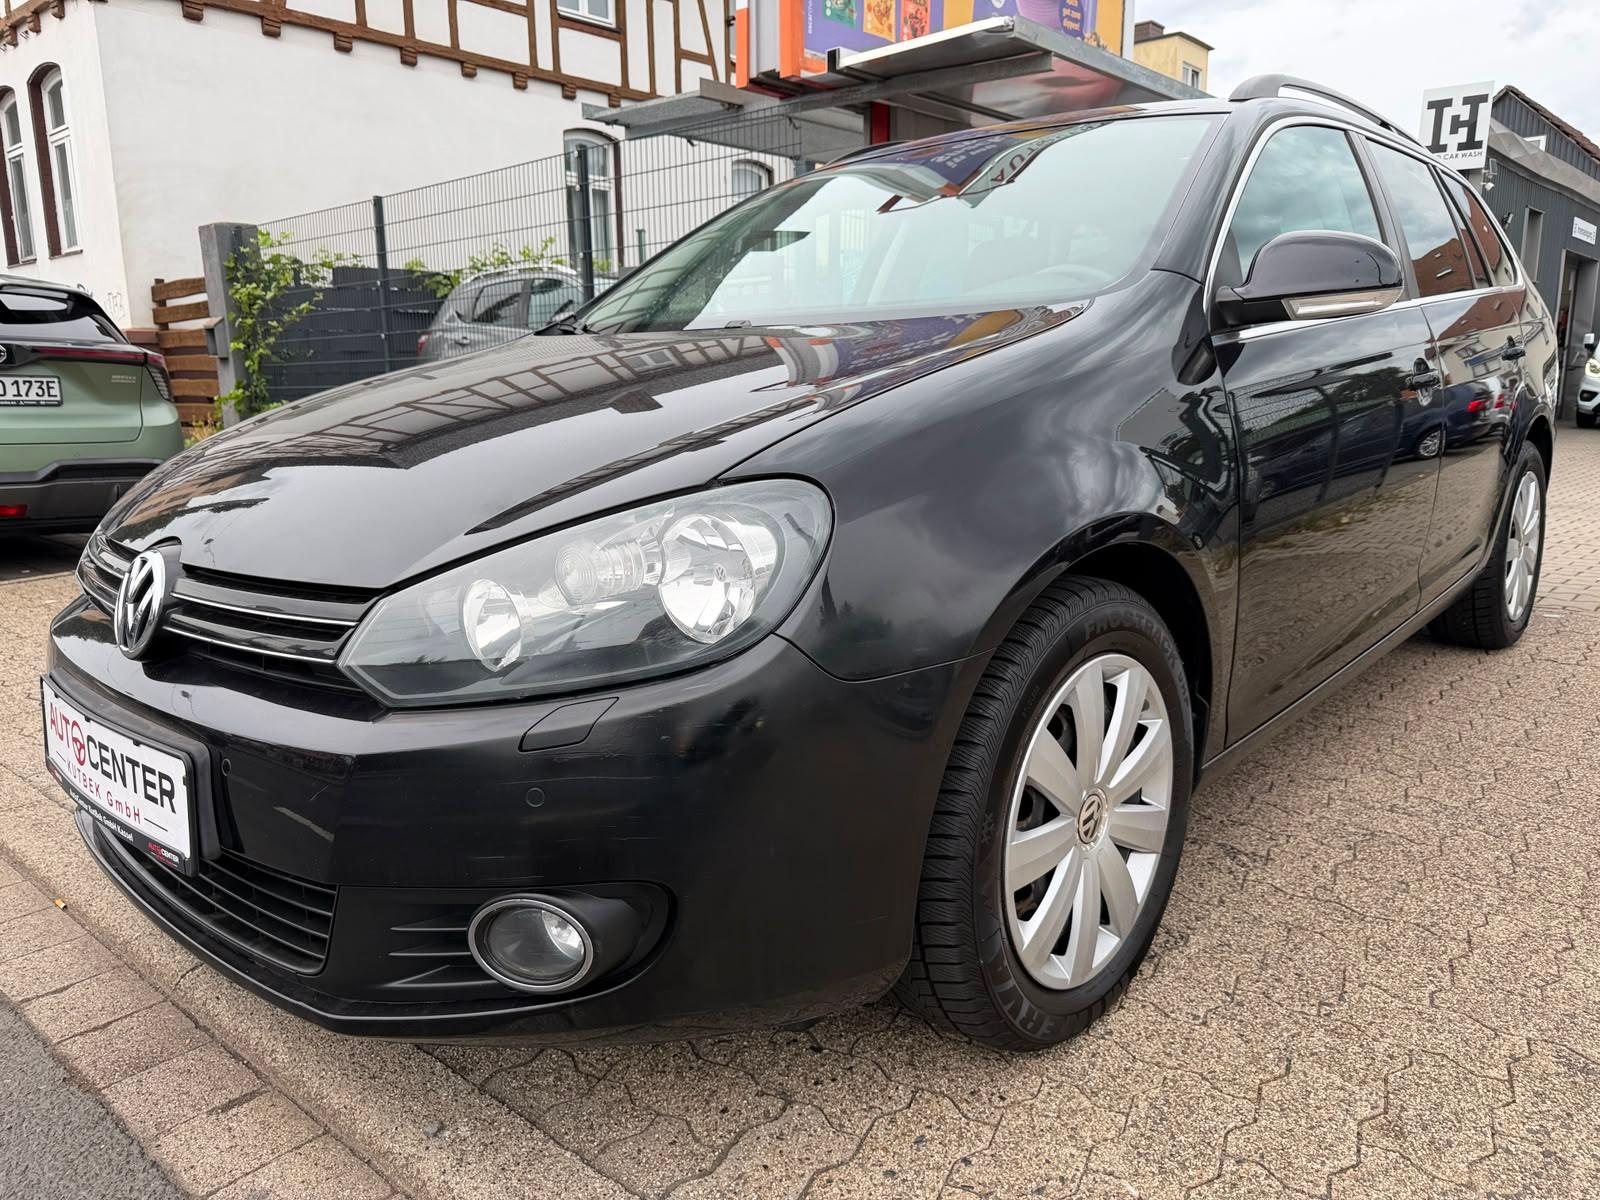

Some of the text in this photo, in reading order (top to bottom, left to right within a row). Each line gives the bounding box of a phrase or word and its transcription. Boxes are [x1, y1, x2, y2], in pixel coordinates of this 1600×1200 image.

[1443, 152, 1459, 161] CAR
[1461, 150, 1483, 159] WASH
[11, 380, 58, 397] 173E
[66, 758, 102, 800] KUTBEK
[106, 790, 141, 825] GmbH
